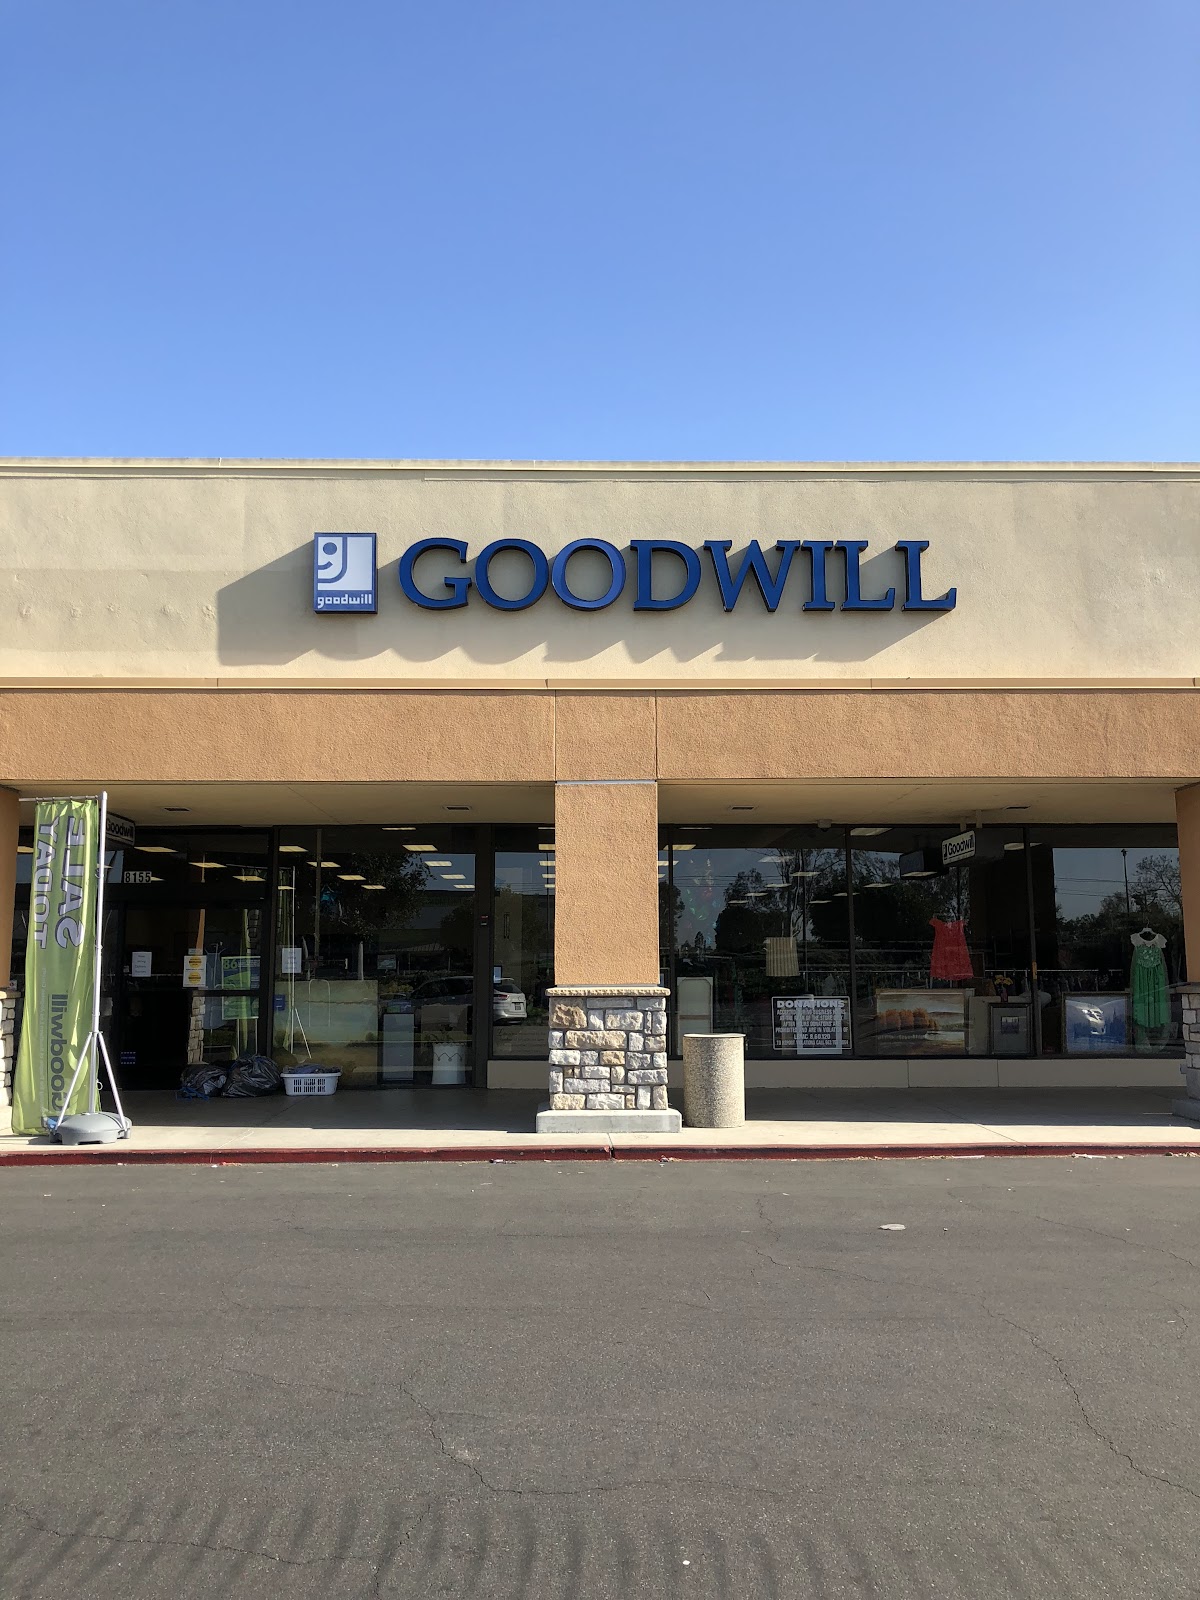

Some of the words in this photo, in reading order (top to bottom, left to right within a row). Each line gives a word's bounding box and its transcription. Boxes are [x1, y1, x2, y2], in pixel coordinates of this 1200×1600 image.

[399, 537, 957, 611] GOODWILL
[317, 593, 372, 609] goodwill
[125, 872, 151, 883] 8155
[777, 1000, 845, 1008] DONATIONS
